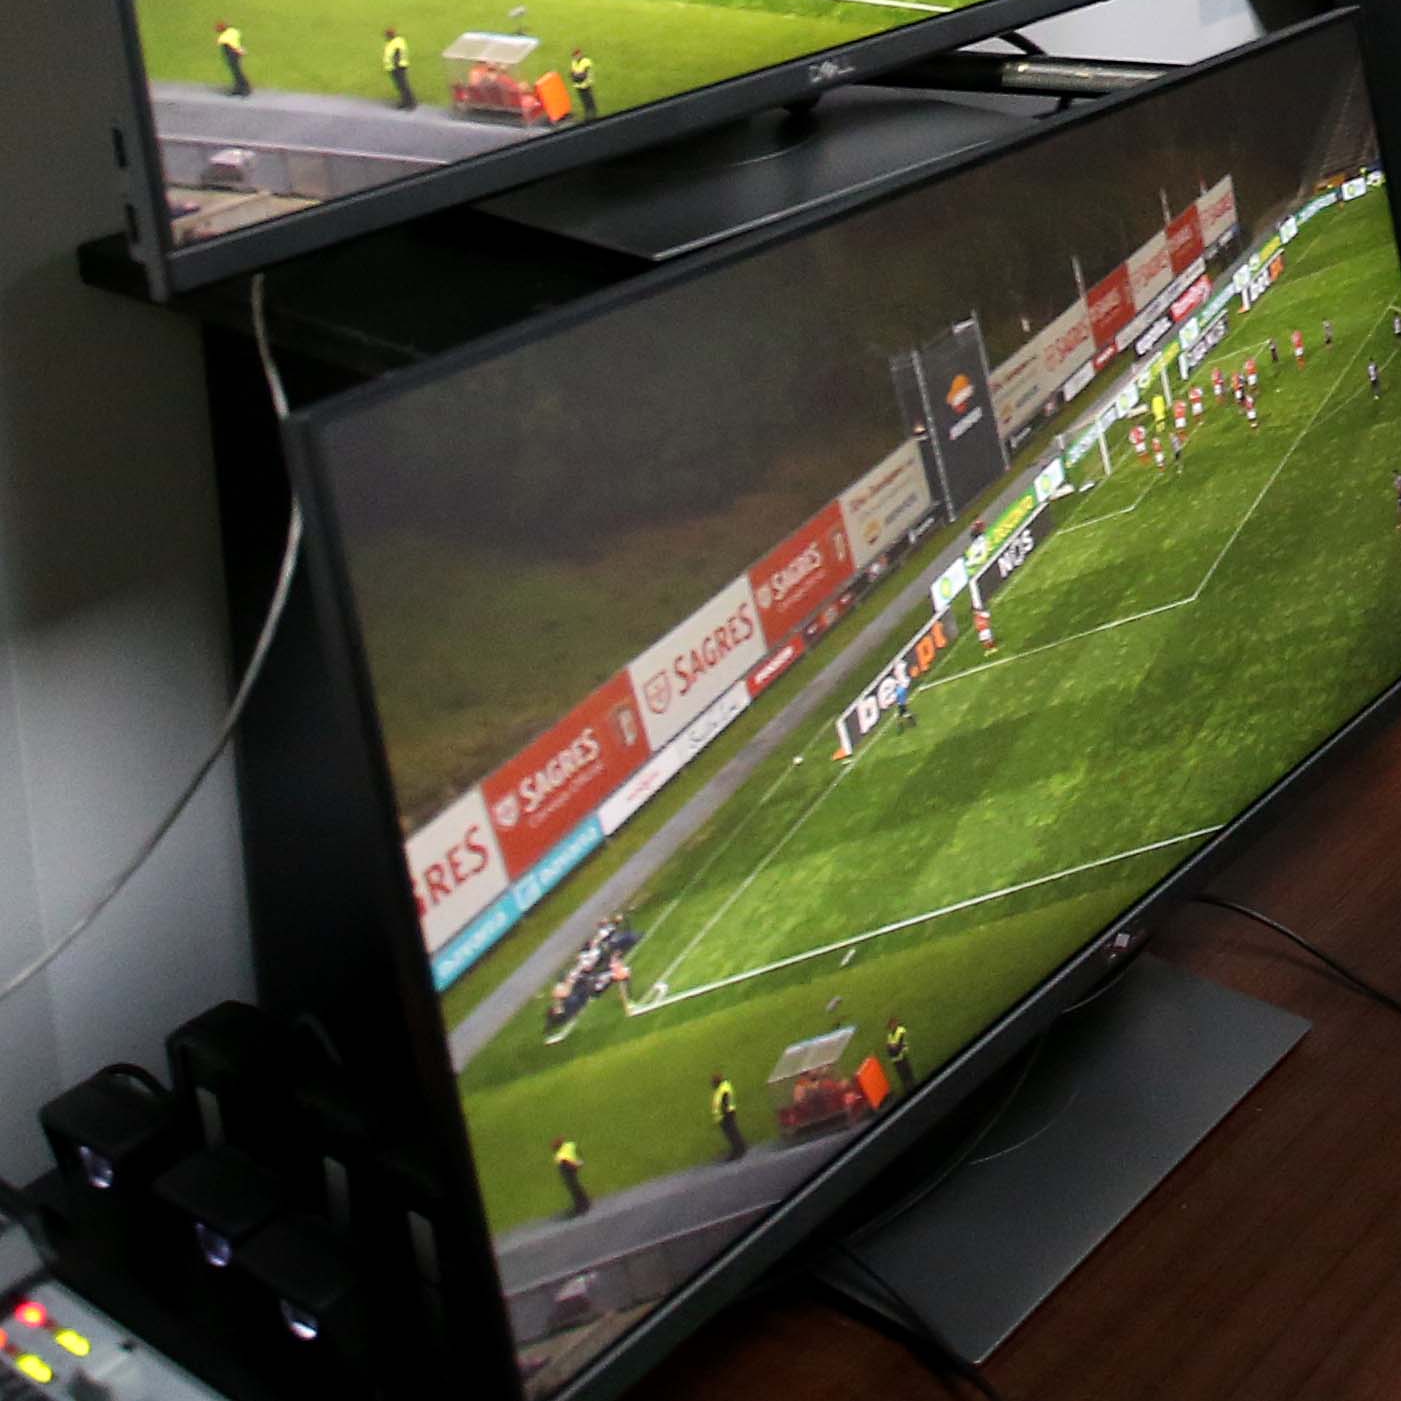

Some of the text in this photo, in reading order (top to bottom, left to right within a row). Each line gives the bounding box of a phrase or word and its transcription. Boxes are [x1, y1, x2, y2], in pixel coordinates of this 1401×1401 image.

[672, 602, 755, 696] SAGRES
[855, 619, 948, 734] bet.pt
[519, 727, 601, 814] SAGRES
